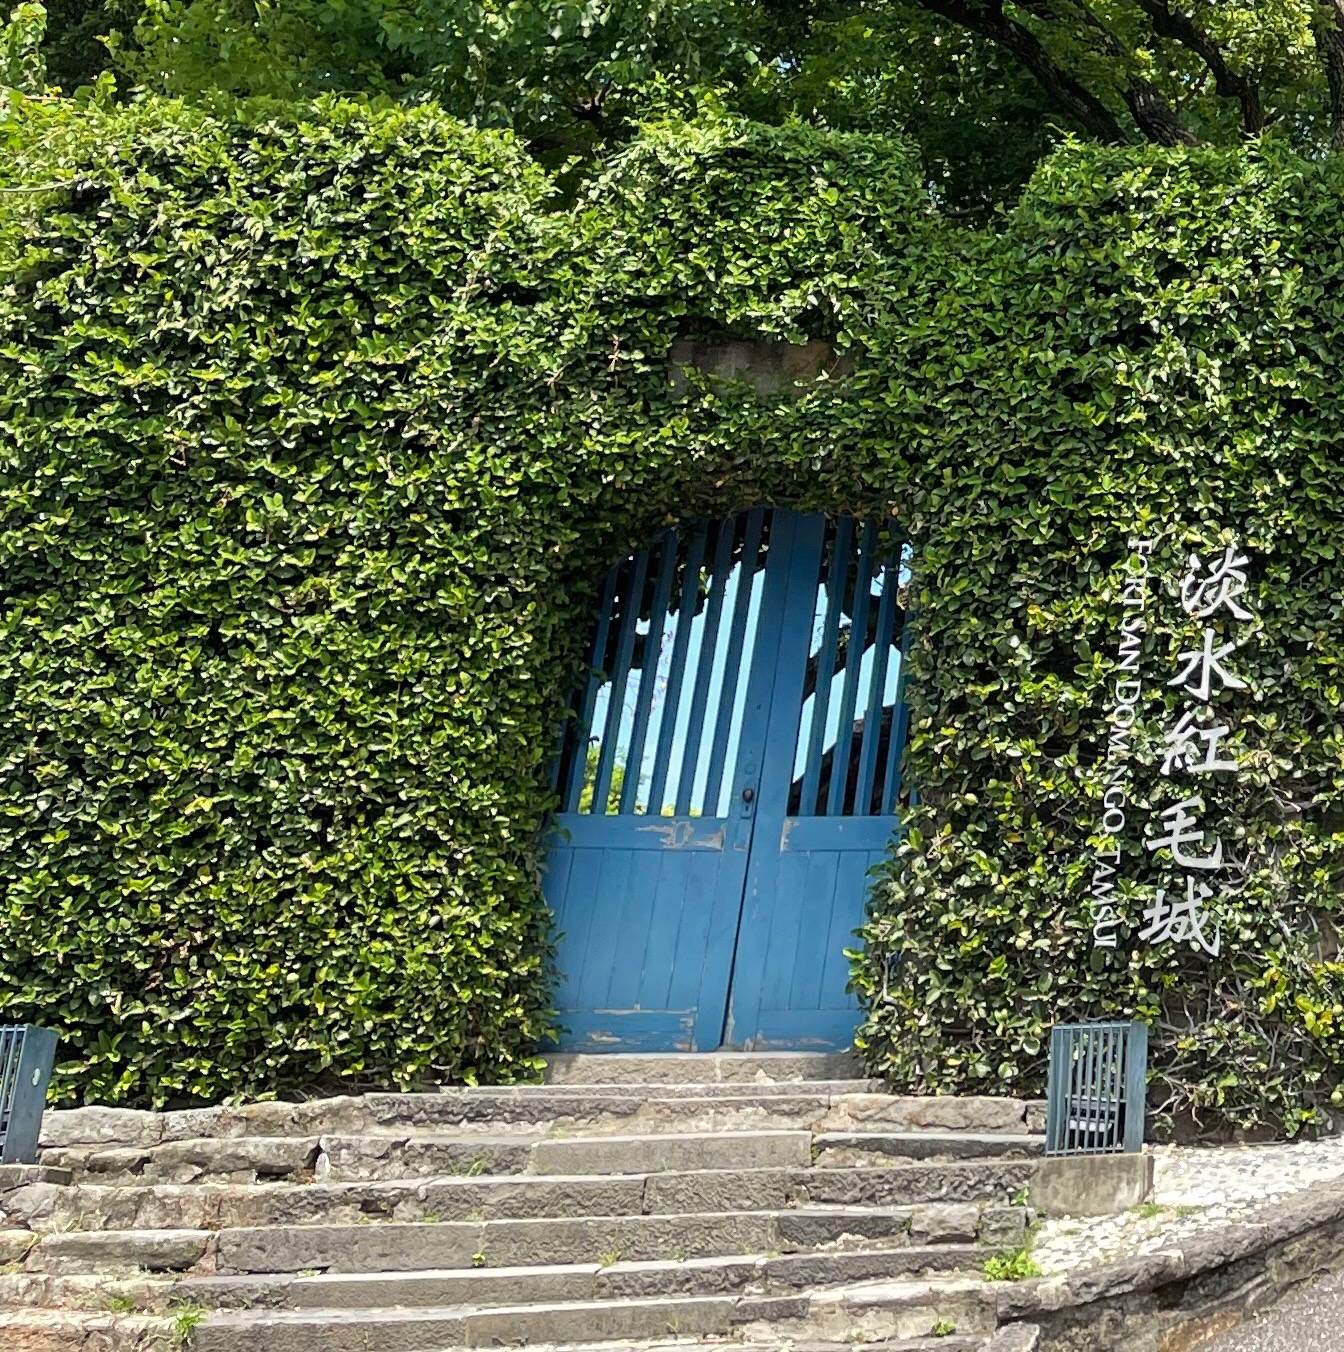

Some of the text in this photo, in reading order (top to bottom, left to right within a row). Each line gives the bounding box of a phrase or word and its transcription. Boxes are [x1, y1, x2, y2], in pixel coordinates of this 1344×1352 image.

[1123, 539, 1152, 611] FORT
[1118, 617, 1144, 674] SAN
[1138, 546, 1254, 957] 淡水紅毛城
[1089, 842, 1121, 948] TAMSUI
